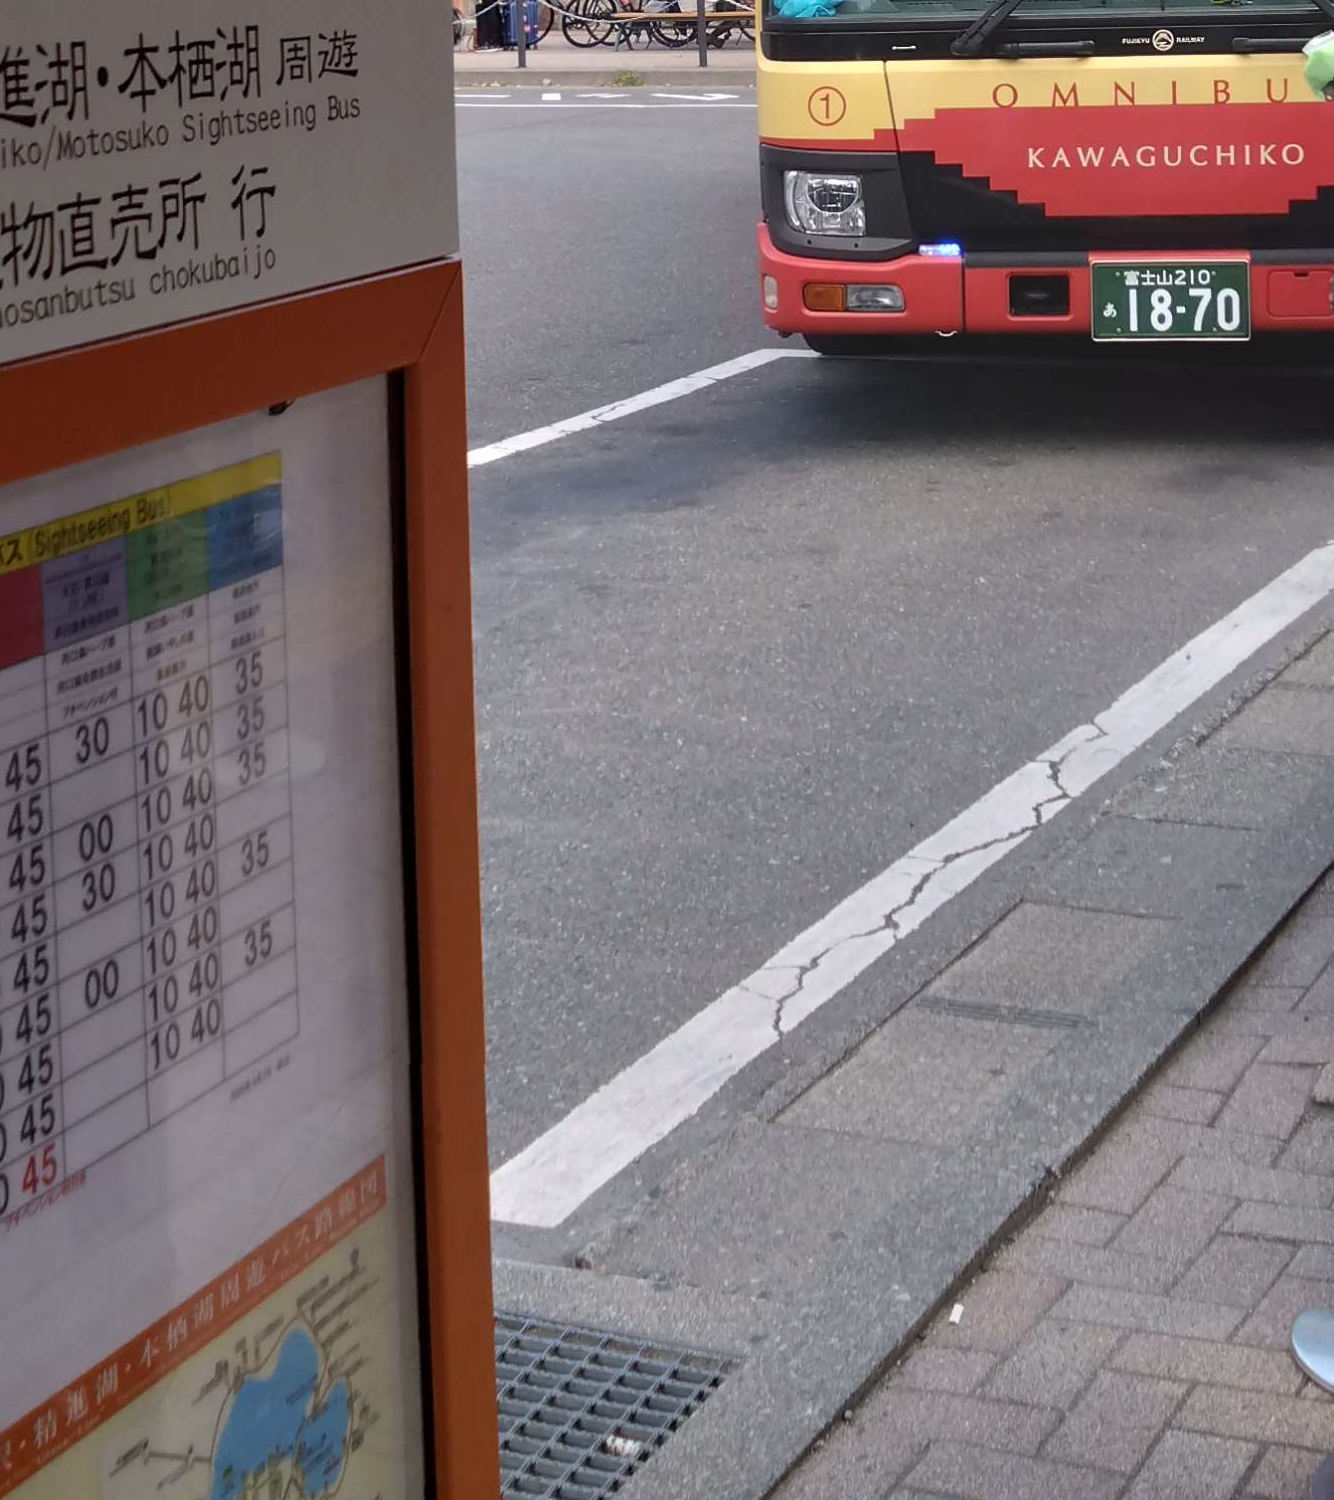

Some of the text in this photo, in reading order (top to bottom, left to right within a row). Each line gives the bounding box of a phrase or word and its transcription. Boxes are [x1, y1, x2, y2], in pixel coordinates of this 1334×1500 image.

[182, 95, 317, 148] Sightseeing
[327, 93, 361, 121] Bus
[1027, 143, 1306, 169] KAWAGUCHIKO
[149, 246, 277, 297] chokubaijo
[1103, 302, 1117, 318] あ
[1129, 288, 1241, 332] 18-70
[5, 742, 42, 792] 45
[75, 715, 110, 765] 30
[137, 691, 168, 739] 10
[178, 673, 211, 718] 40
[234, 650, 263, 696] 35
[7, 792, 44, 843] 45
[138, 739, 168, 787] 10
[180, 715, 213, 765] 40
[236, 694, 265, 742] 35
[8, 843, 46, 893] 45
[78, 813, 114, 863] 00
[140, 785, 172, 834] 10
[181, 768, 214, 812] 40
[237, 739, 267, 786] 35
[10, 891, 48, 943] 45
[82, 861, 116, 912] 30
[142, 833, 173, 882] 10
[184, 812, 215, 858] 40
[13, 943, 50, 994] 45
[144, 880, 175, 928] 10
[185, 859, 216, 905] 40
[241, 828, 270, 877] 35
[15, 991, 52, 1045] 45
[84, 958, 120, 1010] 00
[146, 927, 177, 976] 10
[187, 905, 218, 951] 40
[18, 1043, 54, 1095] 45
[148, 974, 179, 1024] 10
[188, 950, 220, 998] 40
[244, 917, 273, 969] 35
[19, 1091, 56, 1145] 45
[150, 1021, 181, 1071] 10
[190, 997, 223, 1043] 40
[21, 1142, 58, 1195] 45
